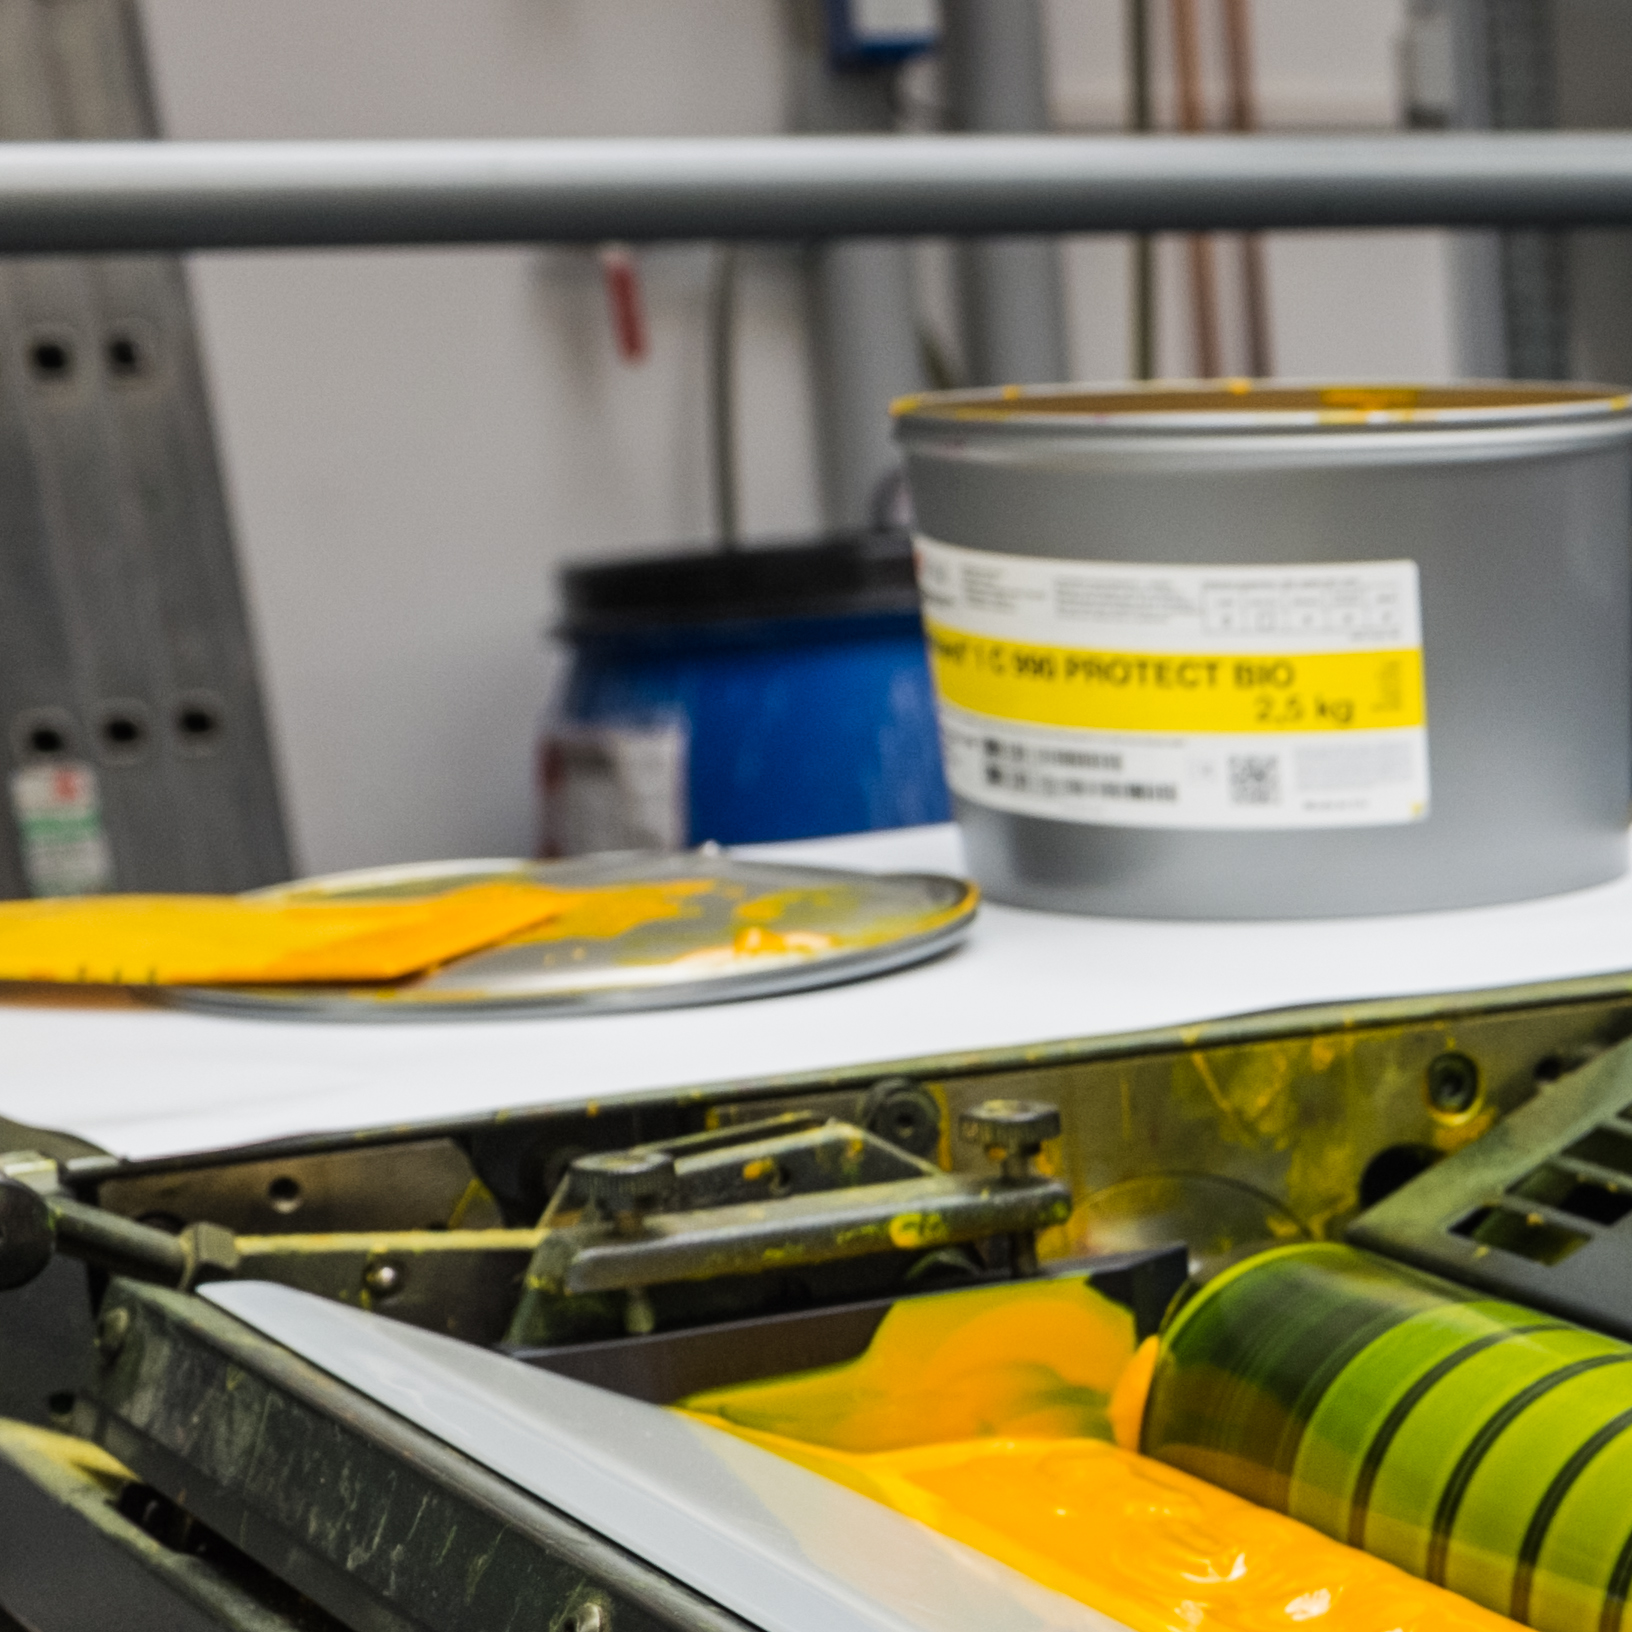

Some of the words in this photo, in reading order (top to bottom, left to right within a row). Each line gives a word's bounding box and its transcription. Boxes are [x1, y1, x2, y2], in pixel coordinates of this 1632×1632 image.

[1064, 657, 1220, 690] PROTECT
[1233, 660, 1297, 690] BIO
[1315, 693, 1355, 727] kg
